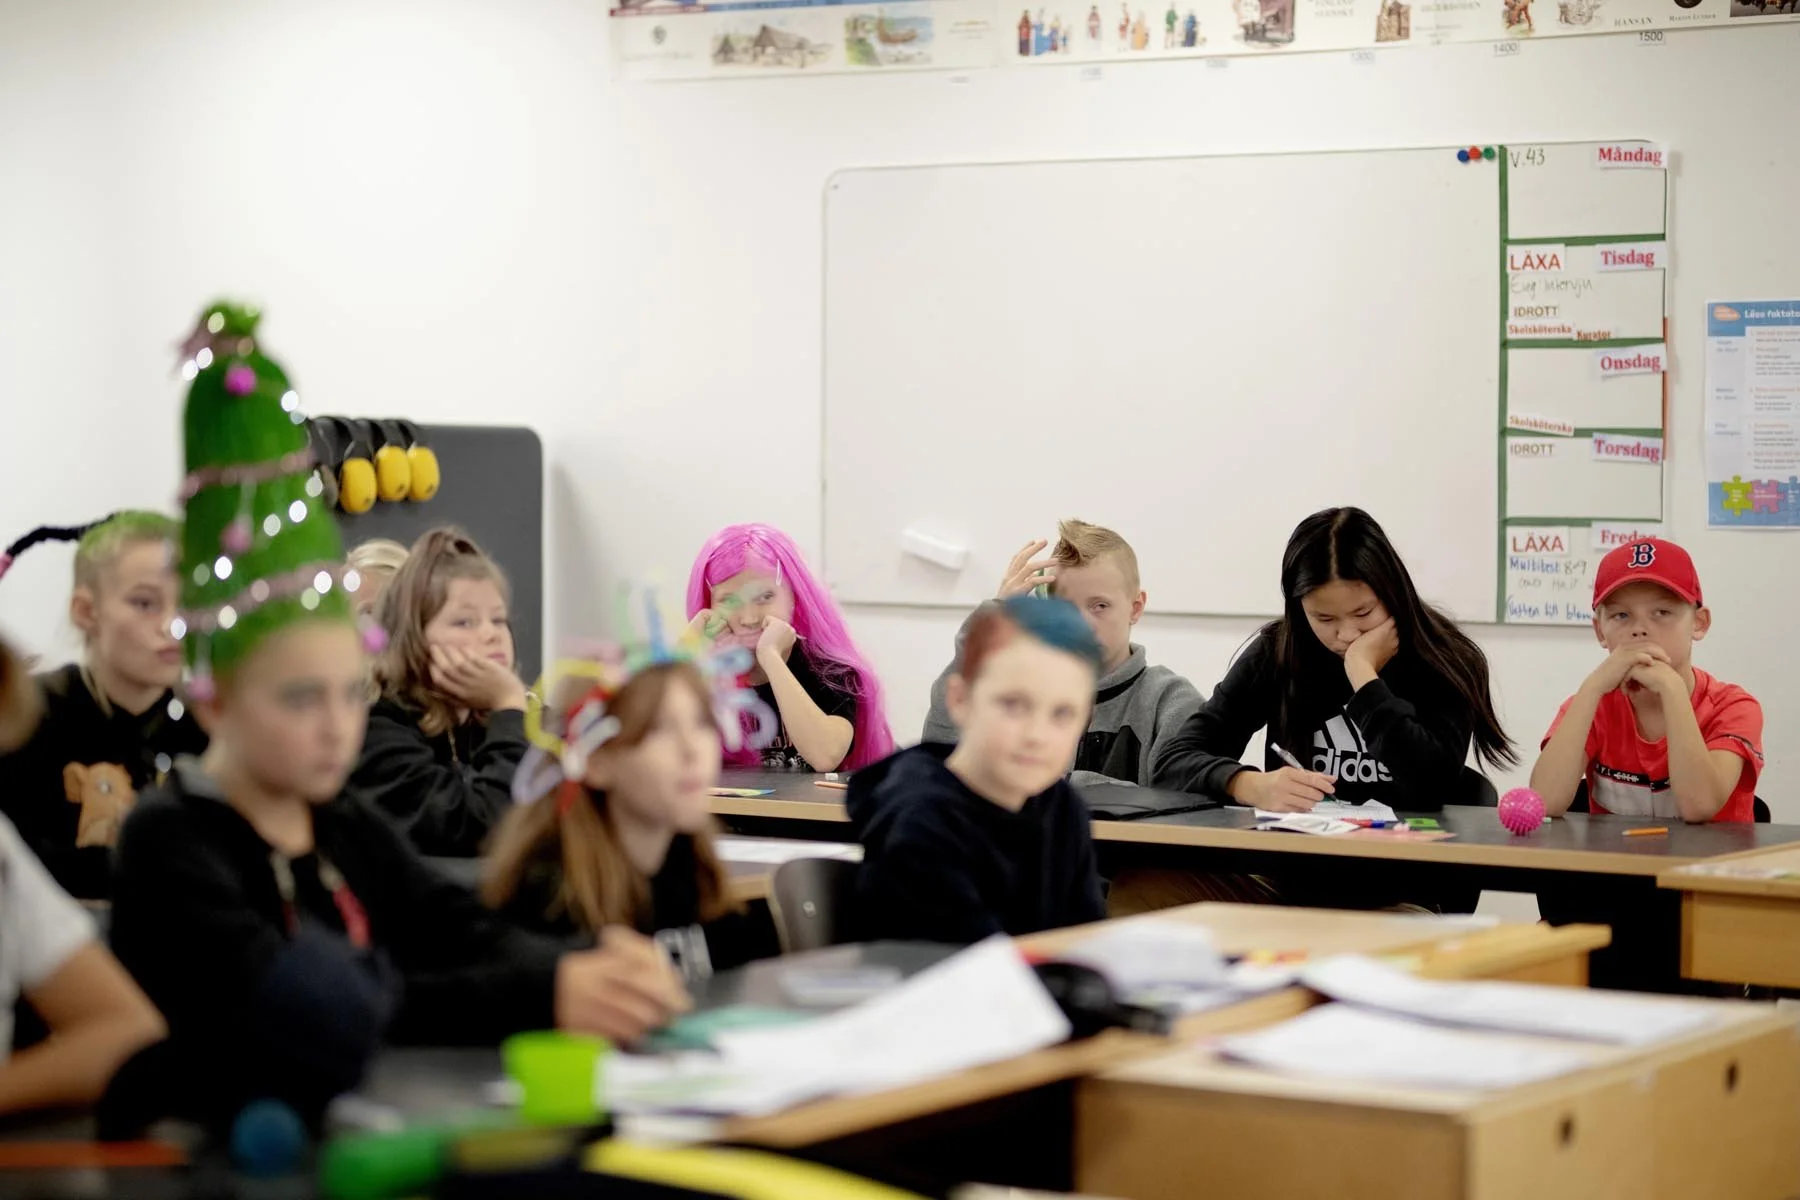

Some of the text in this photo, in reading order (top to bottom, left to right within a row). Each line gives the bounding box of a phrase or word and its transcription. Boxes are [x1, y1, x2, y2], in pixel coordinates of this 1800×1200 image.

[1613, 16, 1653, 28] HANSAN
[1639, 31, 1664, 42] 1500
[1493, 42, 1518, 54] 1400
[1598, 147, 1662, 166] Måndag
[1510, 250, 1561, 271] LÄXA
[1600, 249, 1655, 267] Tisdag
[1513, 305, 1559, 317] IDROTT
[1509, 324, 1572, 335] Skolsköterska
[1601, 353, 1661, 371] Onsdag
[1510, 415, 1573, 433] Skolsköterska
[1510, 443, 1554, 456] IDROTT
[1594, 438, 1660, 463] Torsdag
[1512, 531, 1564, 552] LÄXA
[1627, 542, 1656, 568] B
[1311, 747, 1393, 783] didas
